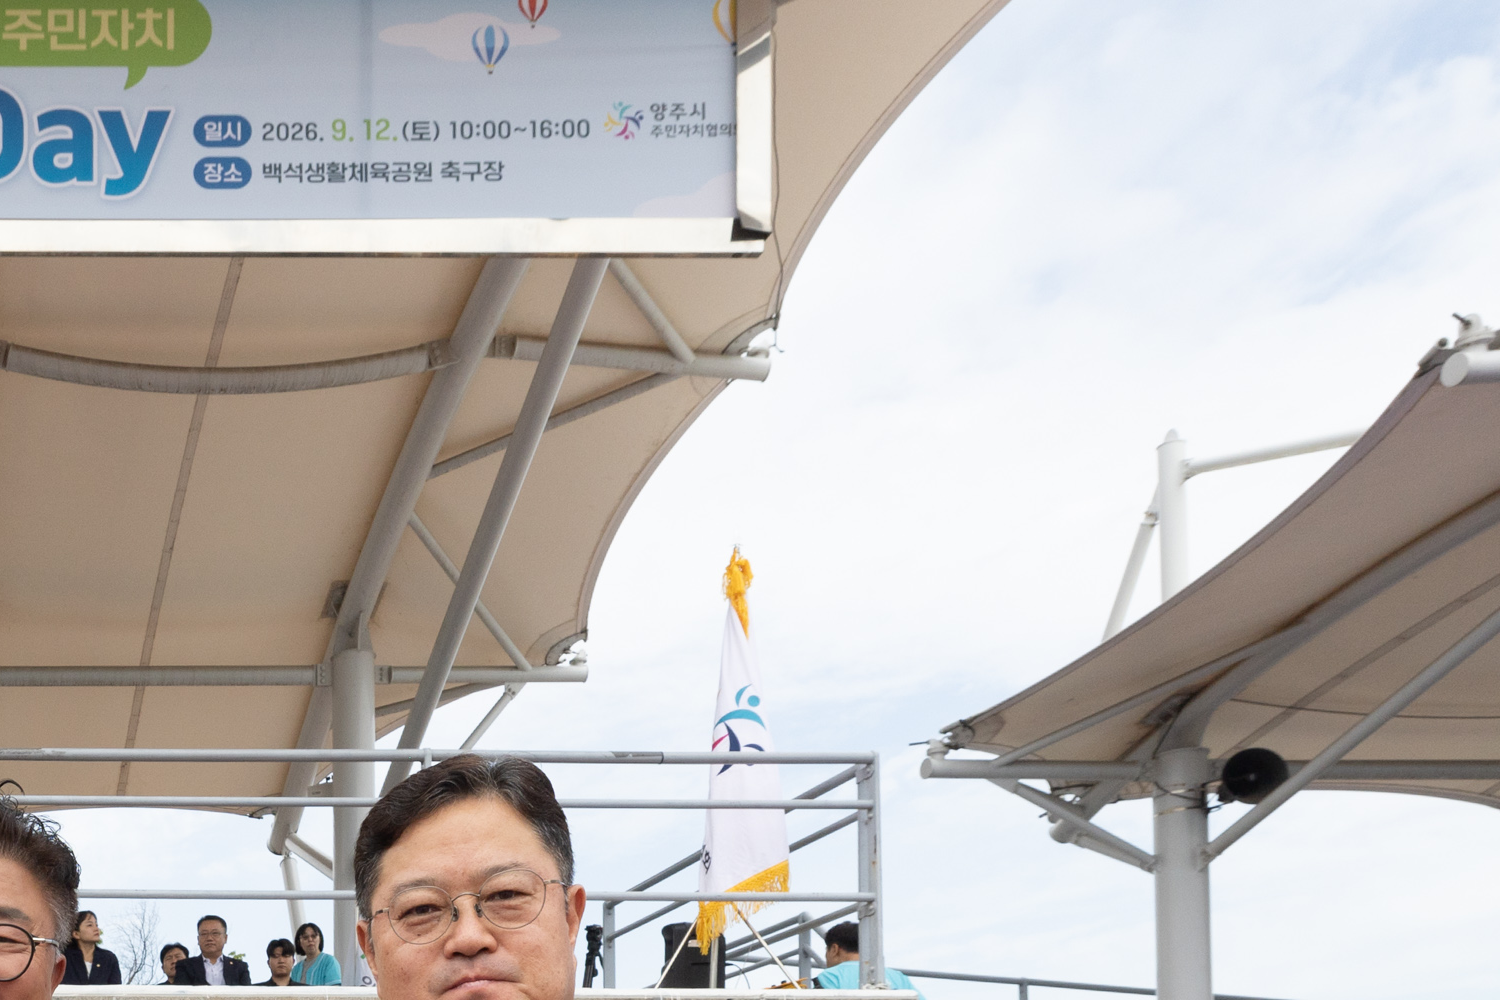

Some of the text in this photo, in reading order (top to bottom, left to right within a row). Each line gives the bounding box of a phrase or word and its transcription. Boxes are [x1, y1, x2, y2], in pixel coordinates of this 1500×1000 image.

[2, 8, 175, 50] 주민자치
[649, 101, 706, 122] 양주시
[203, 120, 242, 142] 일시
[261, 121, 324, 142] 2026.
[331, 118, 355, 142] 9.
[450, 119, 591, 140] 10:00~16:00
[650, 122, 737, 138] 주민자치협의
[203, 161, 505, 184] 장소 백석생활체육공원 축구장
